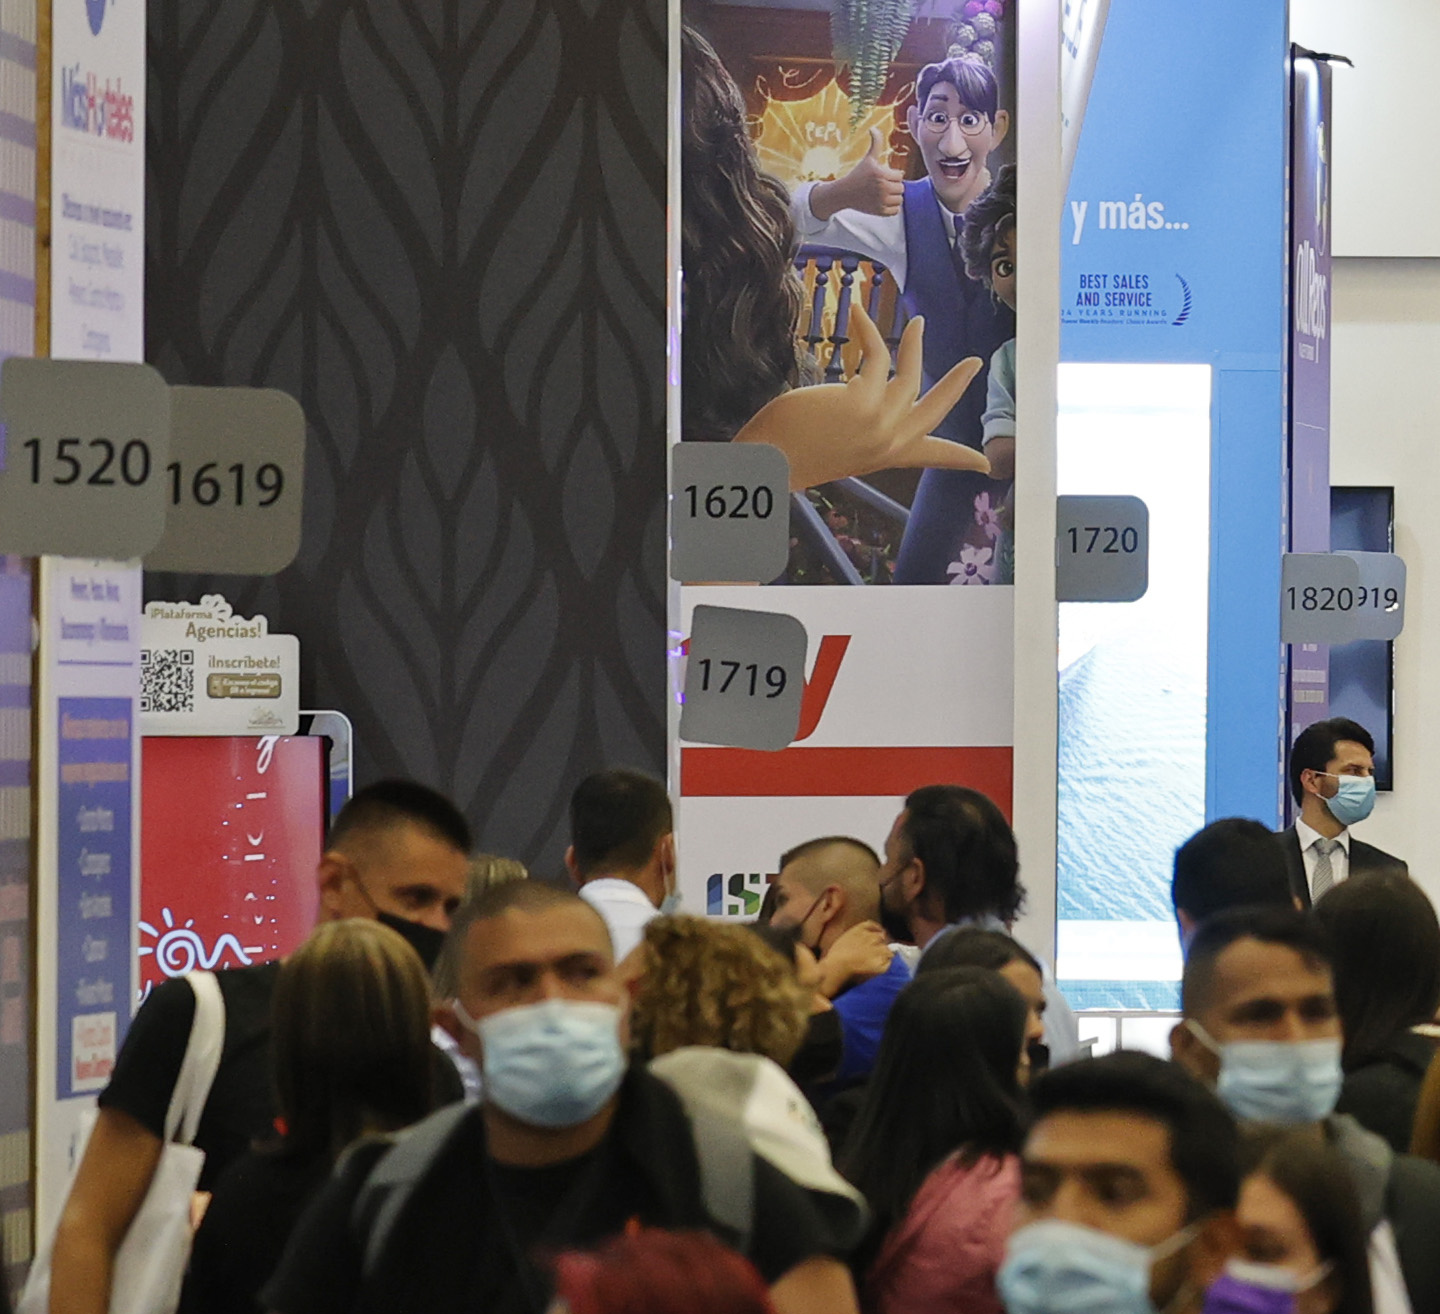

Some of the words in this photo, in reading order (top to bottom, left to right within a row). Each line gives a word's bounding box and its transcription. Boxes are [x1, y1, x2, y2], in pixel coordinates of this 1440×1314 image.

[1070, 200, 1088, 245] y
[1098, 193, 1190, 230] más...
[1079, 273, 1108, 289] BEST
[1113, 274, 1149, 289] SALES
[1076, 291, 1100, 307] AND
[1104, 292, 1152, 307] SERVICE
[1078, 309, 1113, 317] YEARS
[1119, 309, 1168, 317] RUNNING
[22, 438, 151, 487] 1520
[165, 462, 285, 507] 1619
[683, 485, 774, 520] 1620
[1066, 527, 1139, 555] 1720
[1286, 587, 1353, 611] 1820
[1358, 586, 1398, 611] 919
[186, 622, 262, 642] Agencias!
[698, 658, 787, 699] 1719
